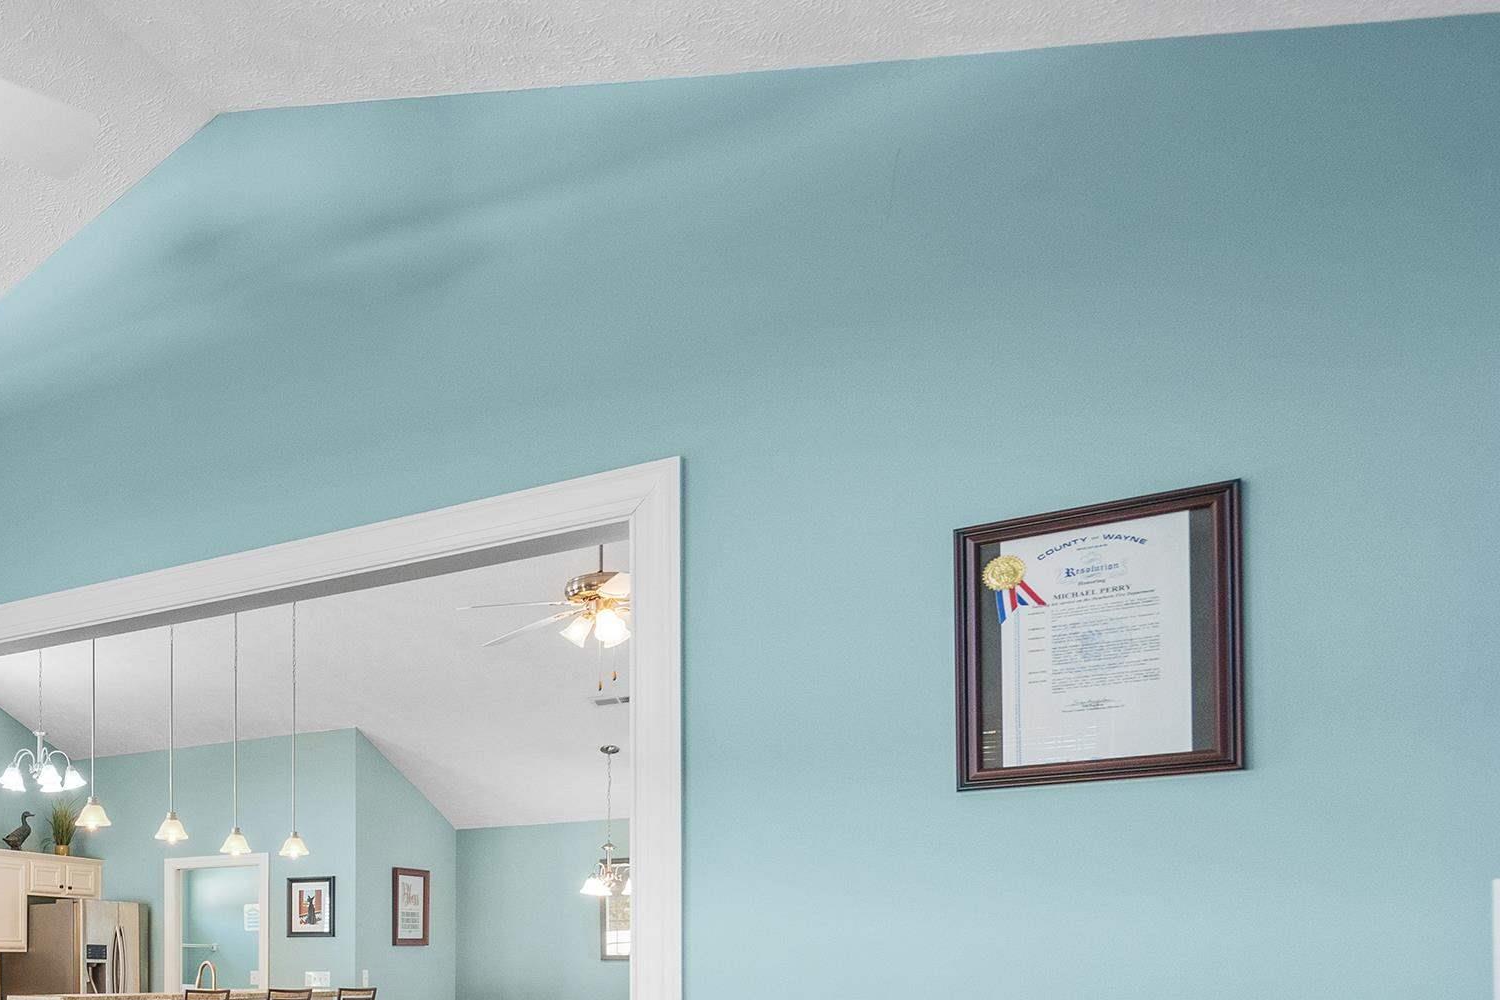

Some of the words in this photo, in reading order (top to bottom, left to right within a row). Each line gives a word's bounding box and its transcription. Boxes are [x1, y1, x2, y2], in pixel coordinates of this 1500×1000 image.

[1037, 536, 1087, 561] COUNTY
[1102, 533, 1148, 545] WAYNE
[1064, 562, 1120, 577] Resolution
[1053, 588, 1097, 600] MICHAEL
[1099, 584, 1131, 594] PERRY
